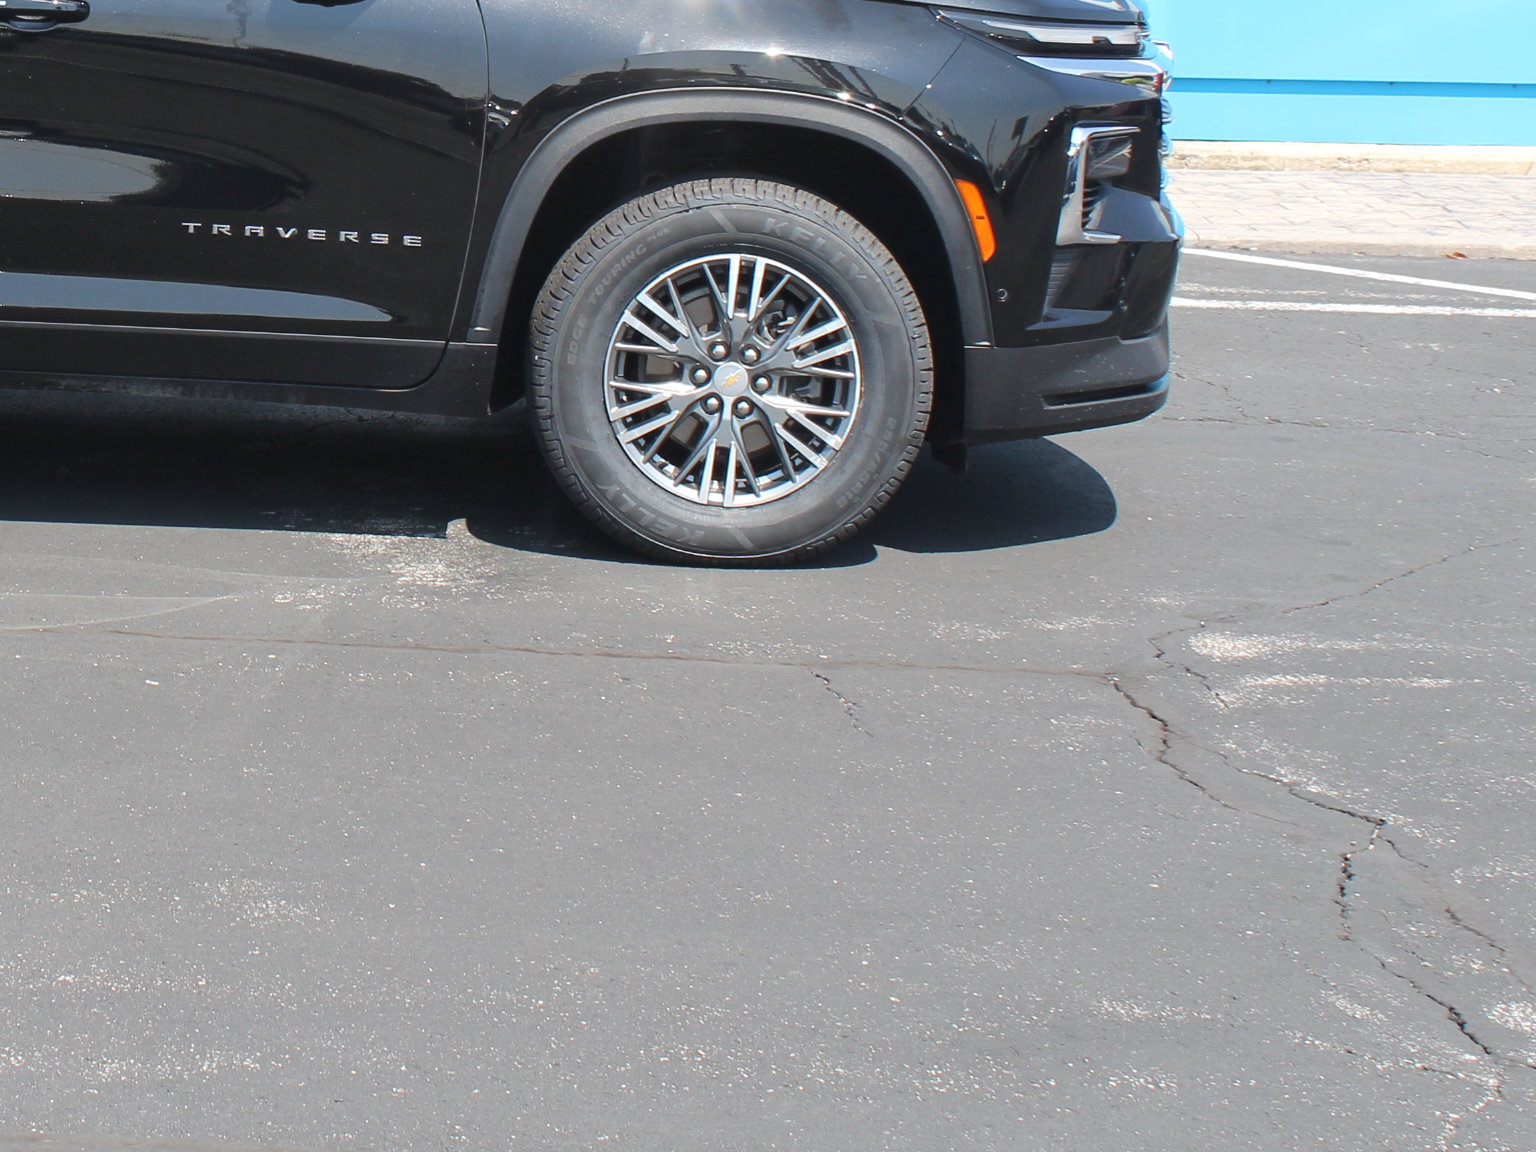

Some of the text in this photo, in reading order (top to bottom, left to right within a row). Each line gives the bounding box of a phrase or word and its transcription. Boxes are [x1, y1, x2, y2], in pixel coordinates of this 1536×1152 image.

[181, 222, 422, 247] TRAVERSE
[763, 217, 868, 281] KELLY
[596, 483, 705, 547] KELLY
